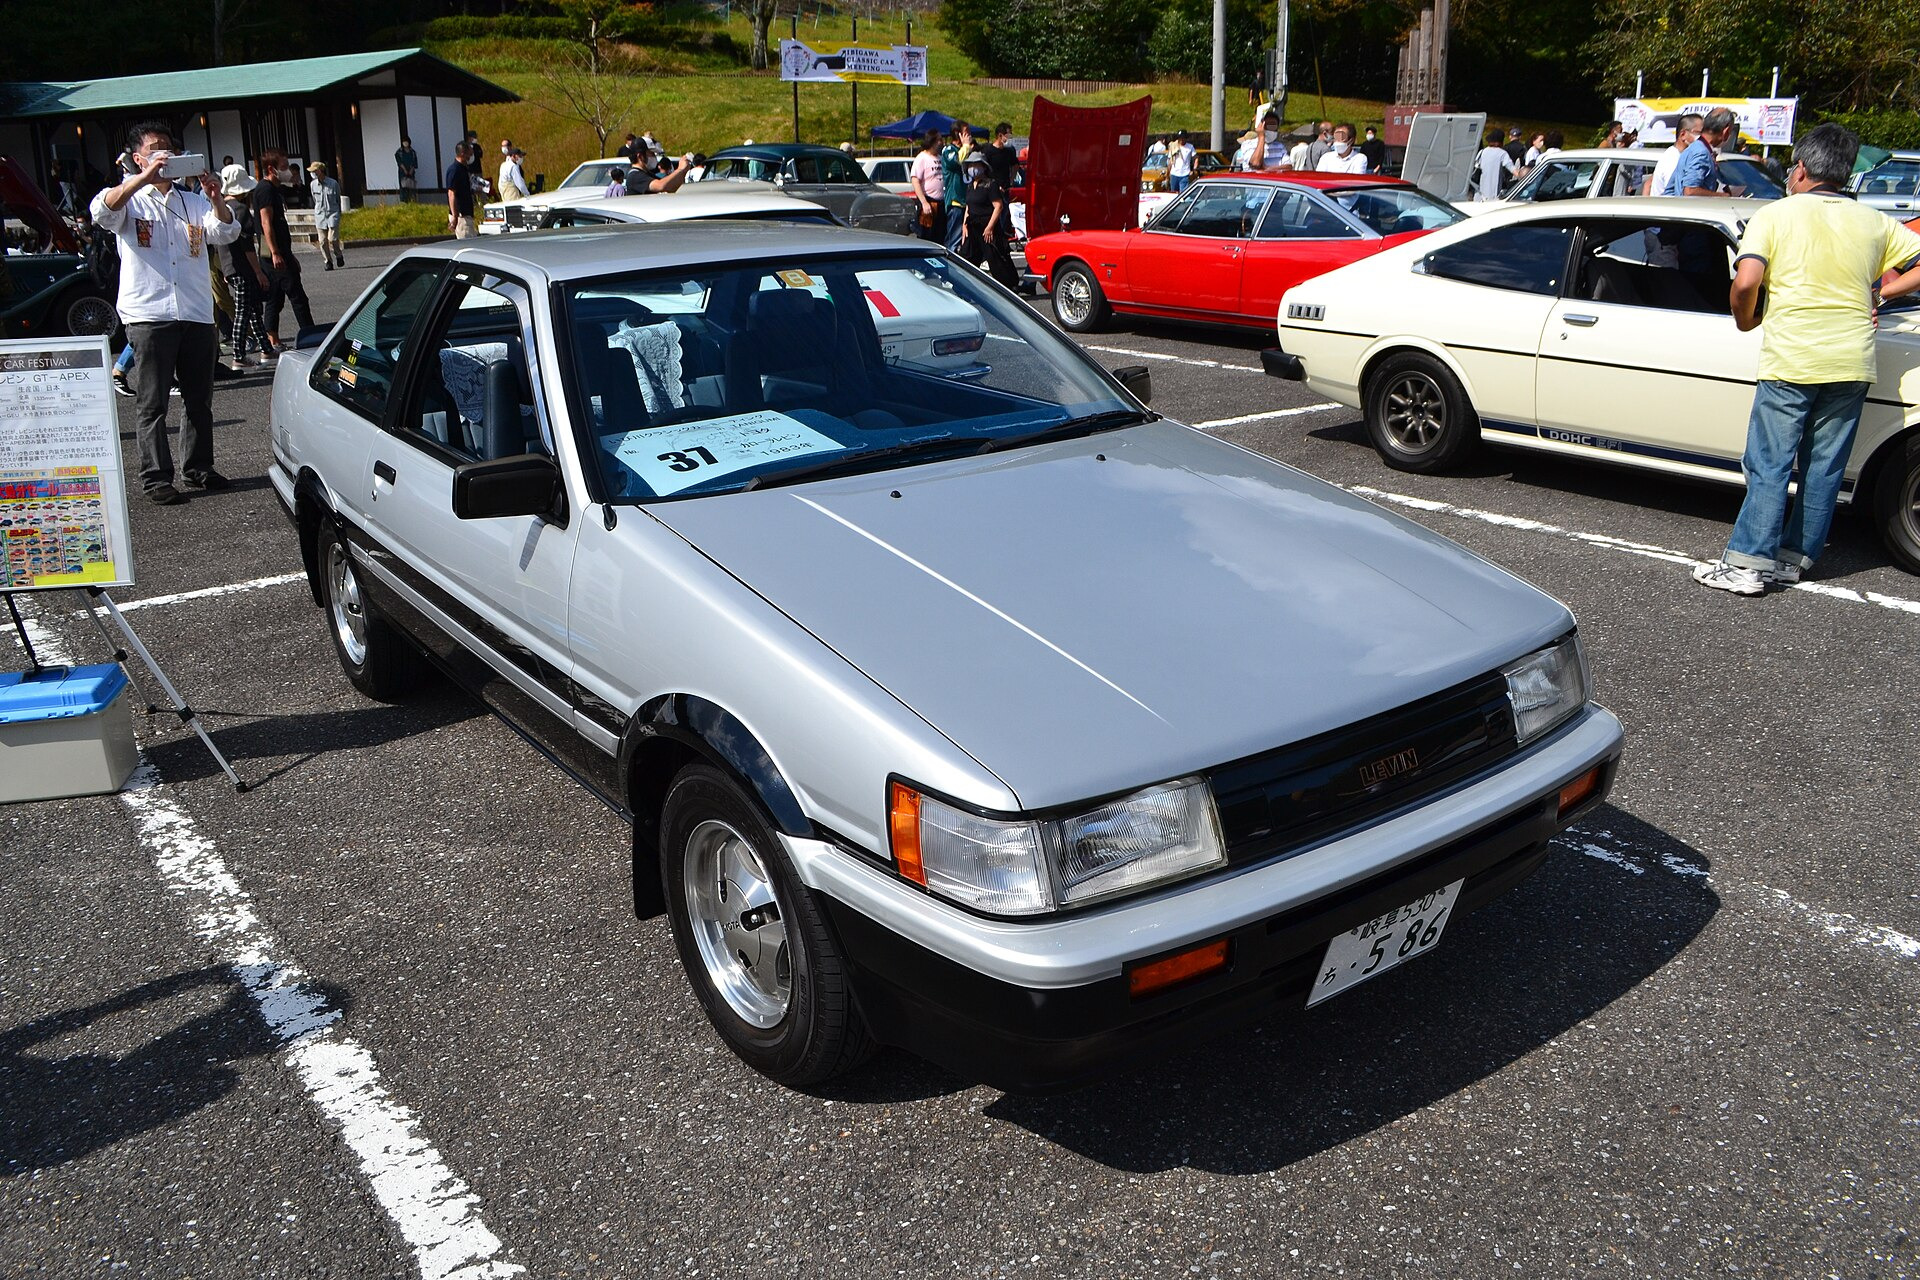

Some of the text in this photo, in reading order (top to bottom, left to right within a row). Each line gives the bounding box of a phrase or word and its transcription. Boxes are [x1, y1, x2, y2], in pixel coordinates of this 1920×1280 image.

[847, 49, 879, 57] IBIGAWA
[847, 64, 880, 72] MEETING
[4, 358, 70, 369] CAR FESTIVAL
[761, 442, 815, 456] 1983年
[1549, 430, 1623, 451] DOHC EFI
[656, 445, 719, 473] 37
[1360, 748, 1419, 787] LEVIN
[1398, 907, 1448, 957] 86
